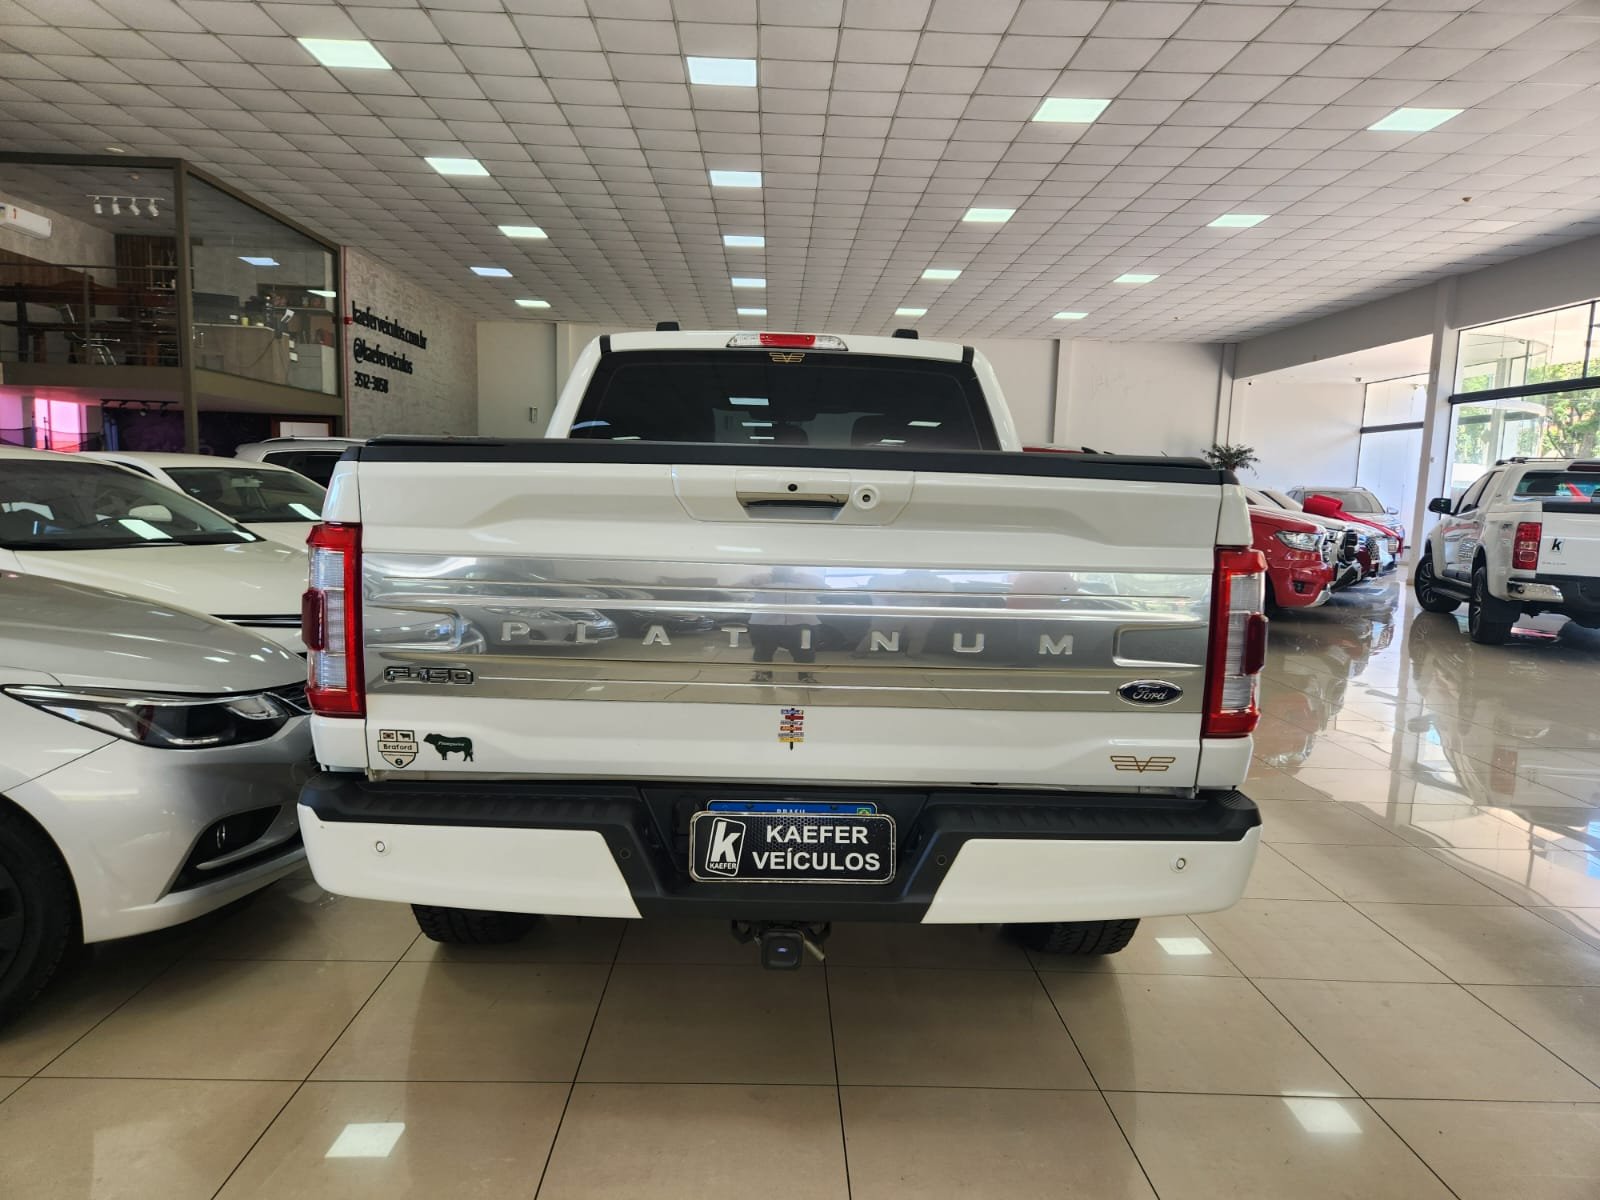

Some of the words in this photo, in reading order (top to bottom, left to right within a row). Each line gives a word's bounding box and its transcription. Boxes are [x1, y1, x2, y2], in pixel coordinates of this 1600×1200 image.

[502, 622, 1073, 655] PLATINUM
[384, 666, 474, 685] F-150
[1132, 685, 1168, 700] Ford
[383, 743, 412, 751] Braford
[766, 825, 869, 844] KAEFER
[709, 861, 737, 870] KAEFER
[752, 848, 881, 871] VEÍCULOS
